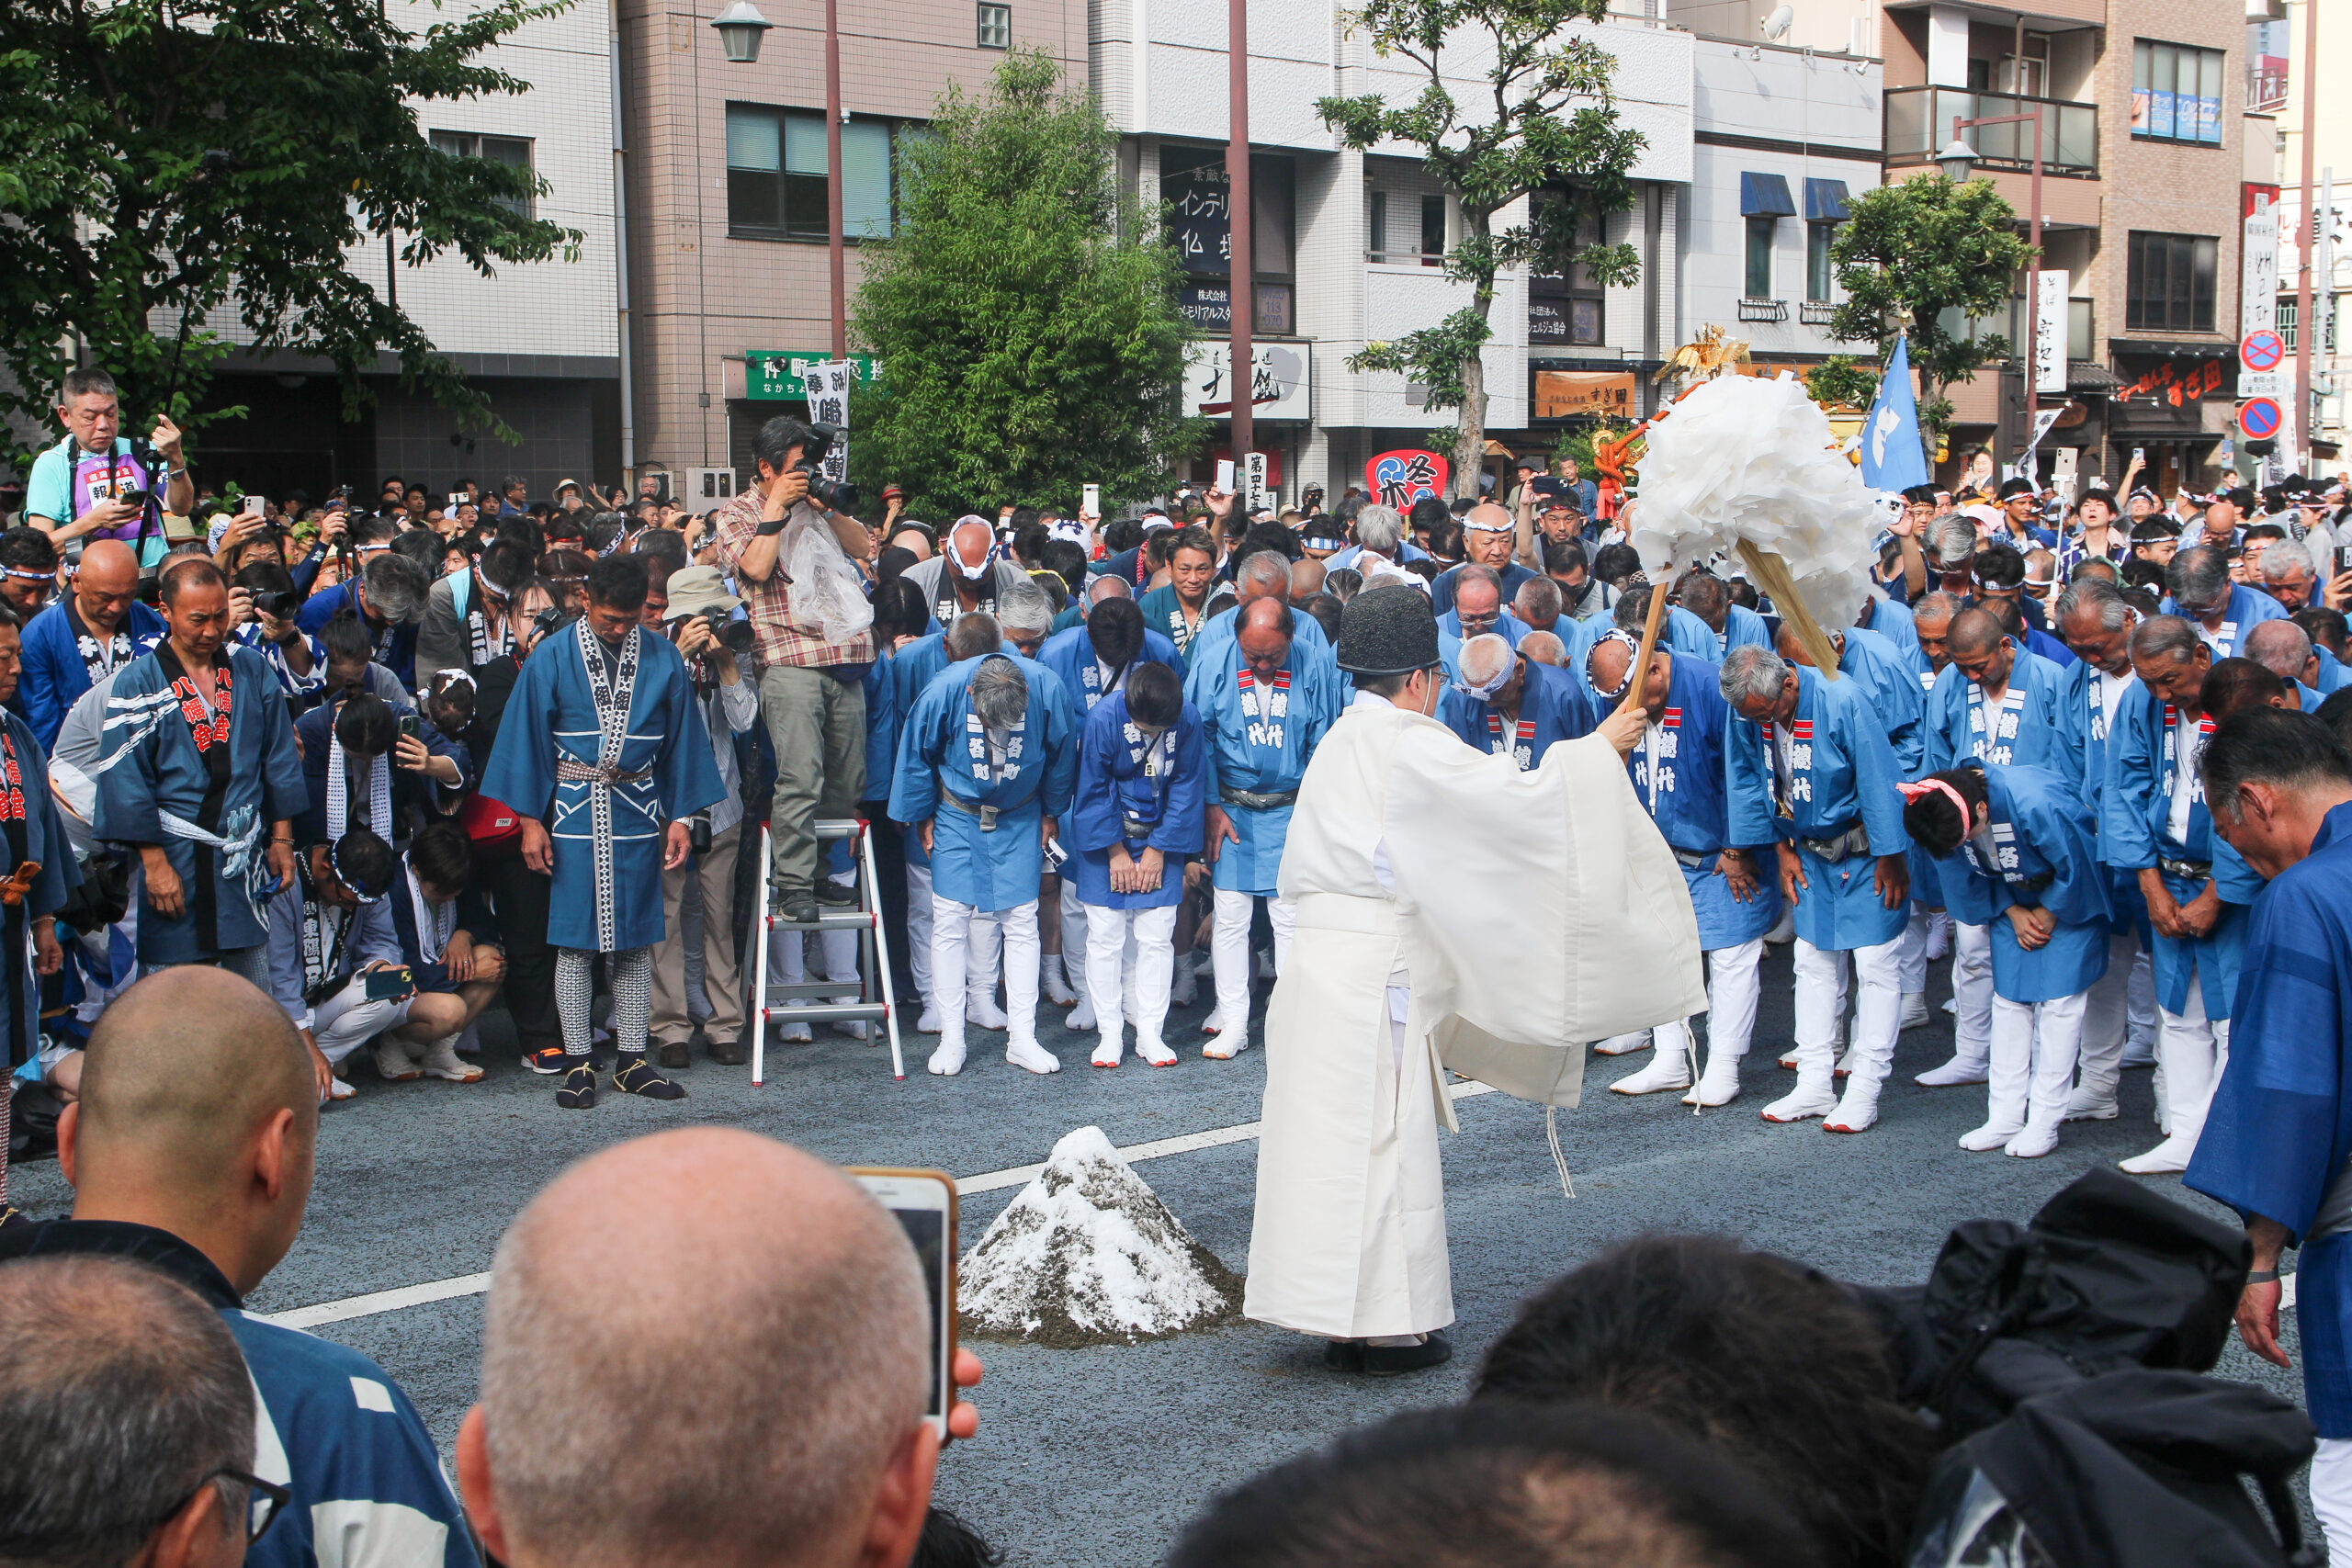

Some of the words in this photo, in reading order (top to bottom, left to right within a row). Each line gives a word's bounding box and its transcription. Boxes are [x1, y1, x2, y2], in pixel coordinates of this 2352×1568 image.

[1198, 289, 1228, 302] 株式会社
[968, 737, 990, 781] 各町
[1002, 736, 1023, 781] 各町
